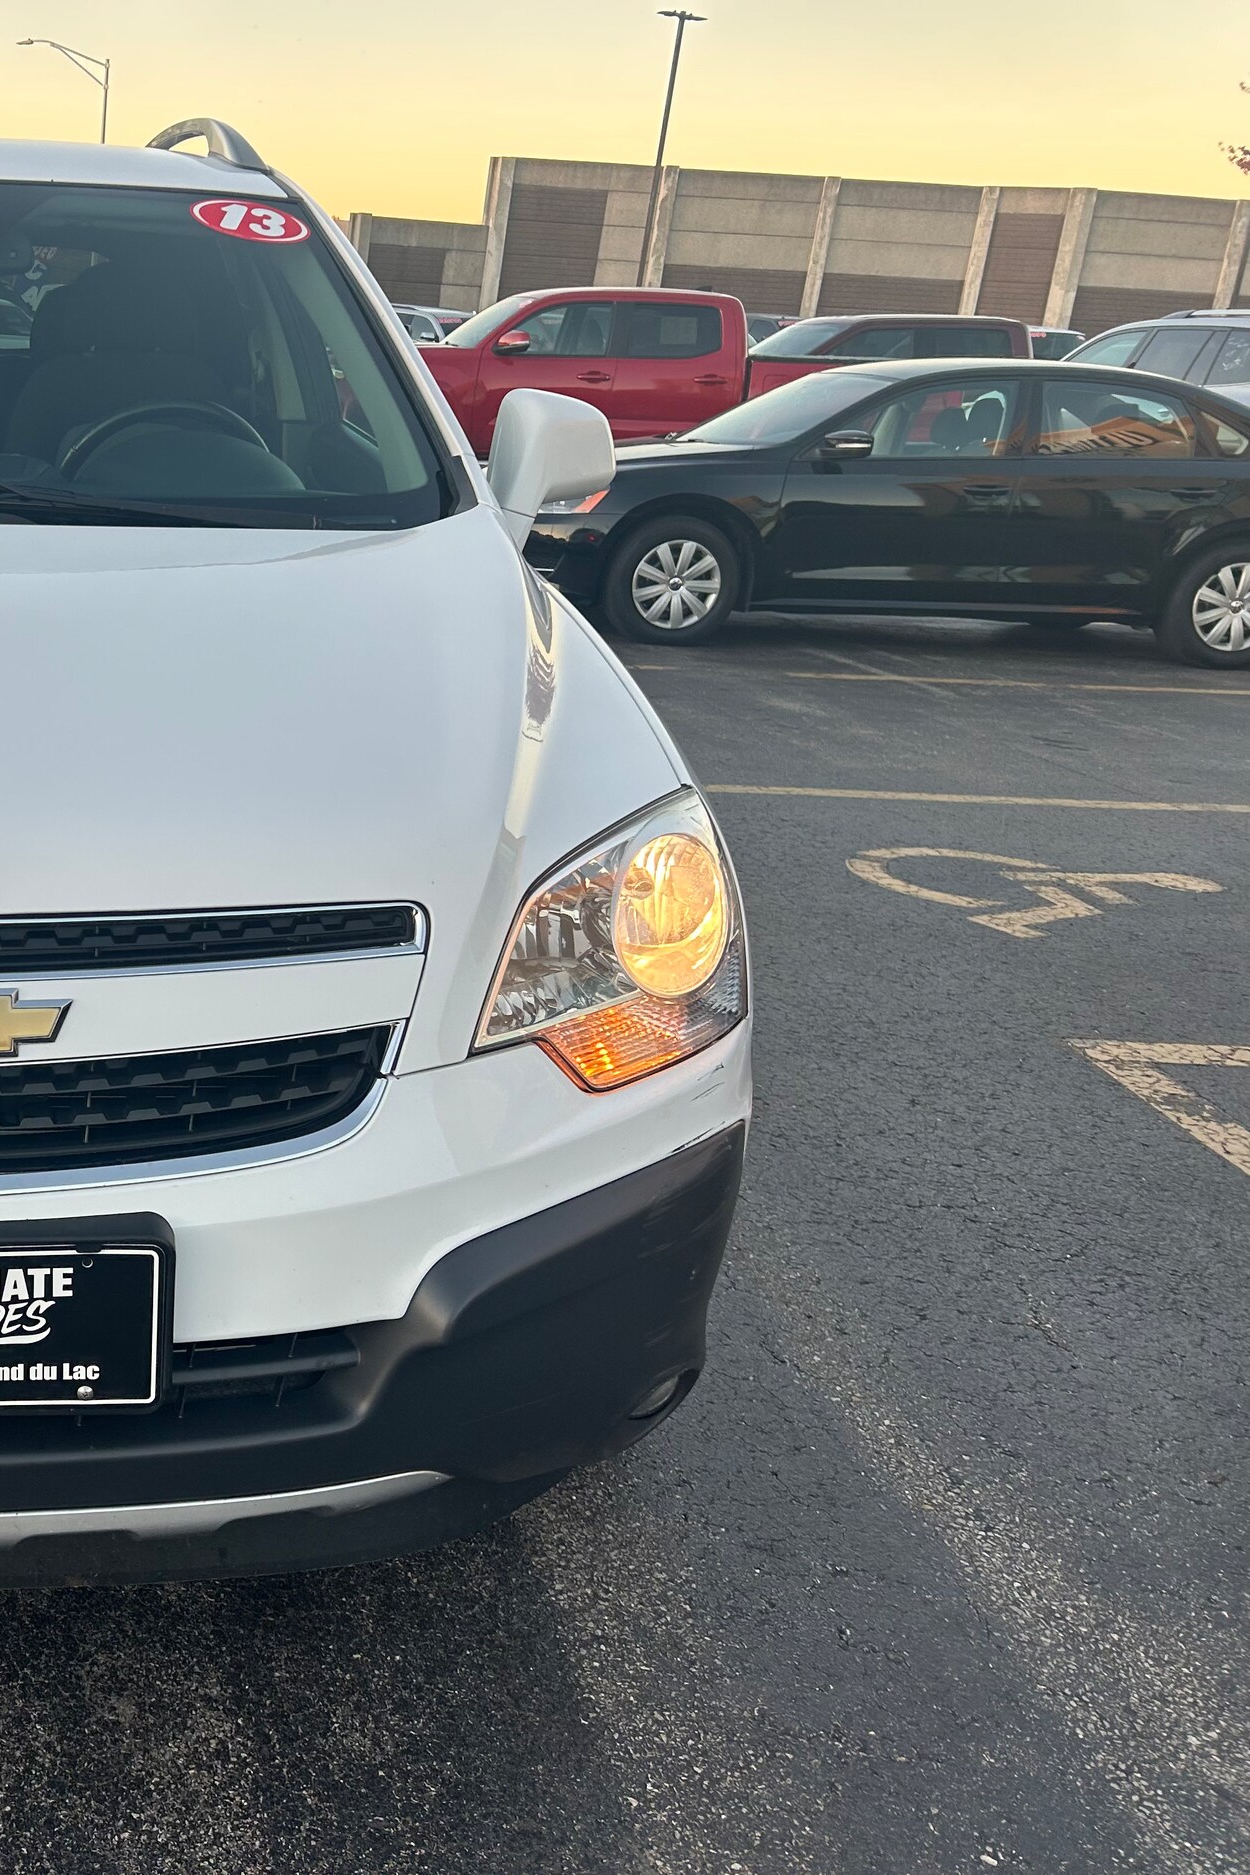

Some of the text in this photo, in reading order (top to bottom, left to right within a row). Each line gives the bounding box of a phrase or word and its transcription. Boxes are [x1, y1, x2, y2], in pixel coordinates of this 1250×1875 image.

[220, 204, 286, 237] 13
[30, 1363, 58, 1381] du
[63, 1363, 101, 1380] Lac
